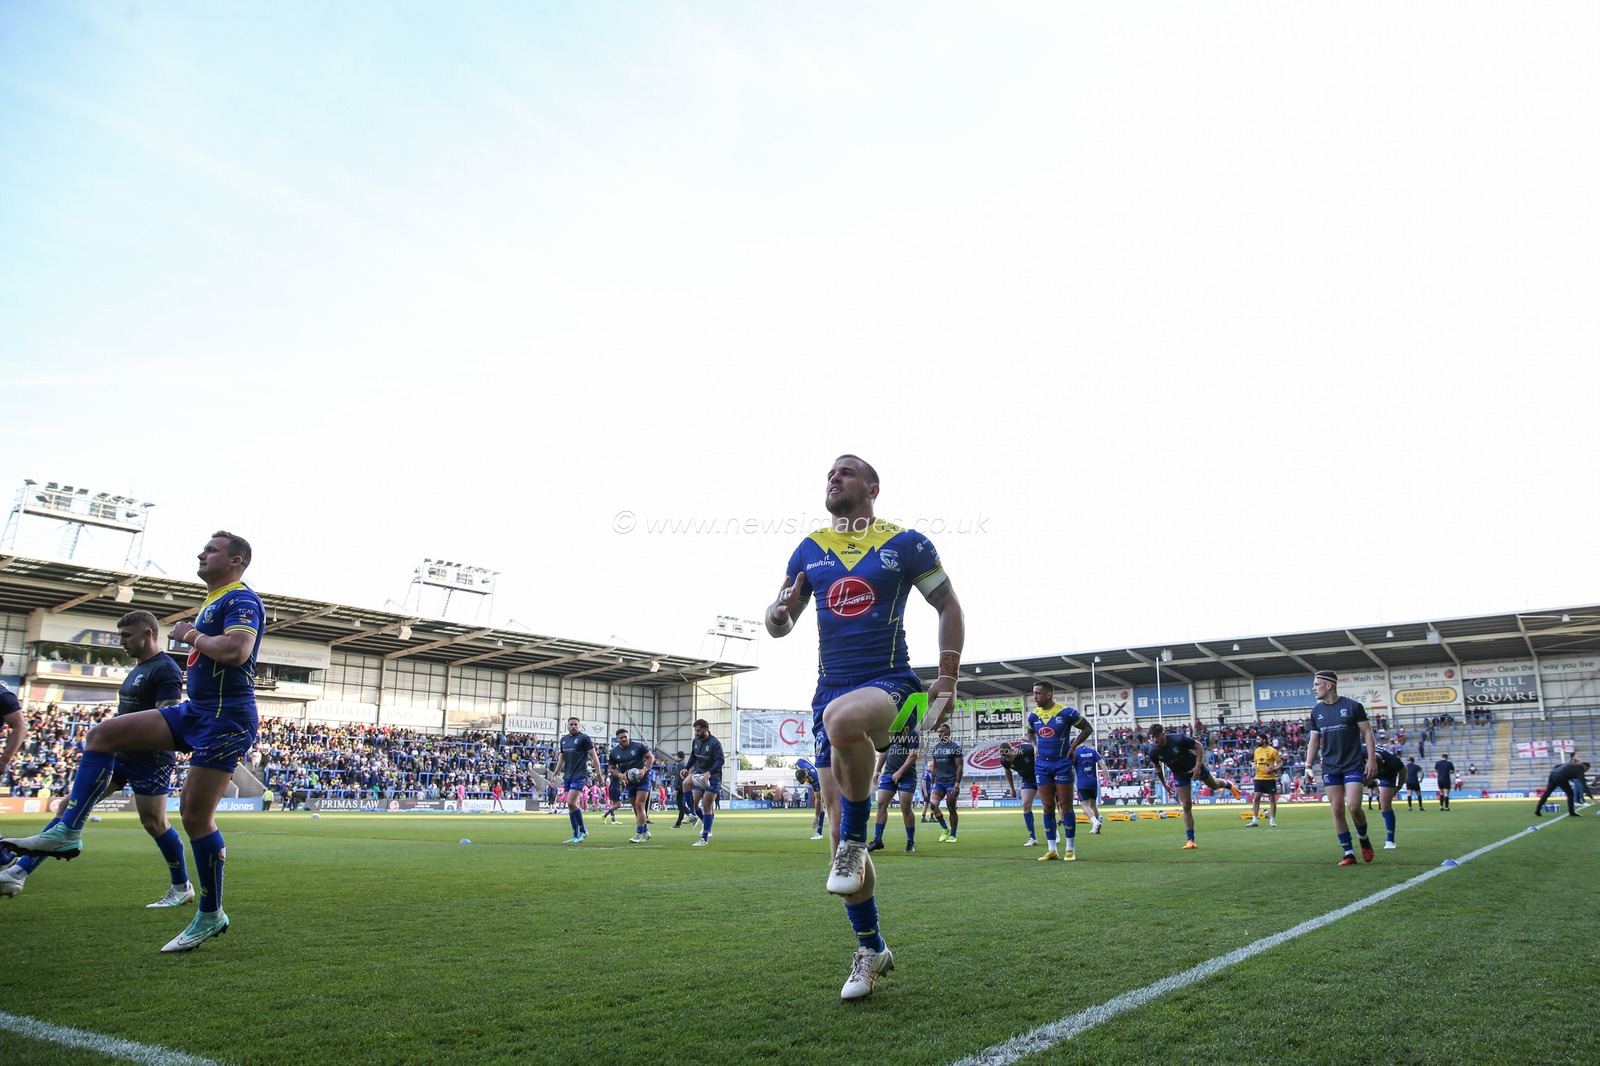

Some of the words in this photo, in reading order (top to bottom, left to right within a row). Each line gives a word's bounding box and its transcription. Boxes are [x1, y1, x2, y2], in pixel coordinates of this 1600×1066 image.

[806, 559, 835, 571] Resulting
[1467, 667, 1496, 675] Hoover.
[1498, 665, 1521, 673] Clean
[1521, 664, 1535, 672] the
[1542, 663, 1559, 671] way
[1561, 662, 1577, 670] you
[1578, 660, 1594, 668] live
[1373, 673, 1385, 681] the
[1391, 674, 1406, 682] way
[1408, 673, 1422, 681] you
[1424, 670, 1438, 678] live
[1473, 676, 1527, 687] GRILL
[1272, 688, 1312, 698] TYSERS
[1402, 690, 1450, 698] WARRINGTON
[1466, 691, 1537, 704] SQUARE
[1151, 696, 1185, 705] TYSERS
[1402, 695, 1451, 703] FABRICATIONS
[1084, 702, 1128, 717] CDX
[978, 712, 1022, 724] FUELHUB
[508, 719, 555, 730] HALLIWELL
[229, 802, 254, 811] Jones
[321, 800, 358, 809] PRIMAS
[360, 800, 380, 809] LAW
[463, 801, 492, 809] Watsons
